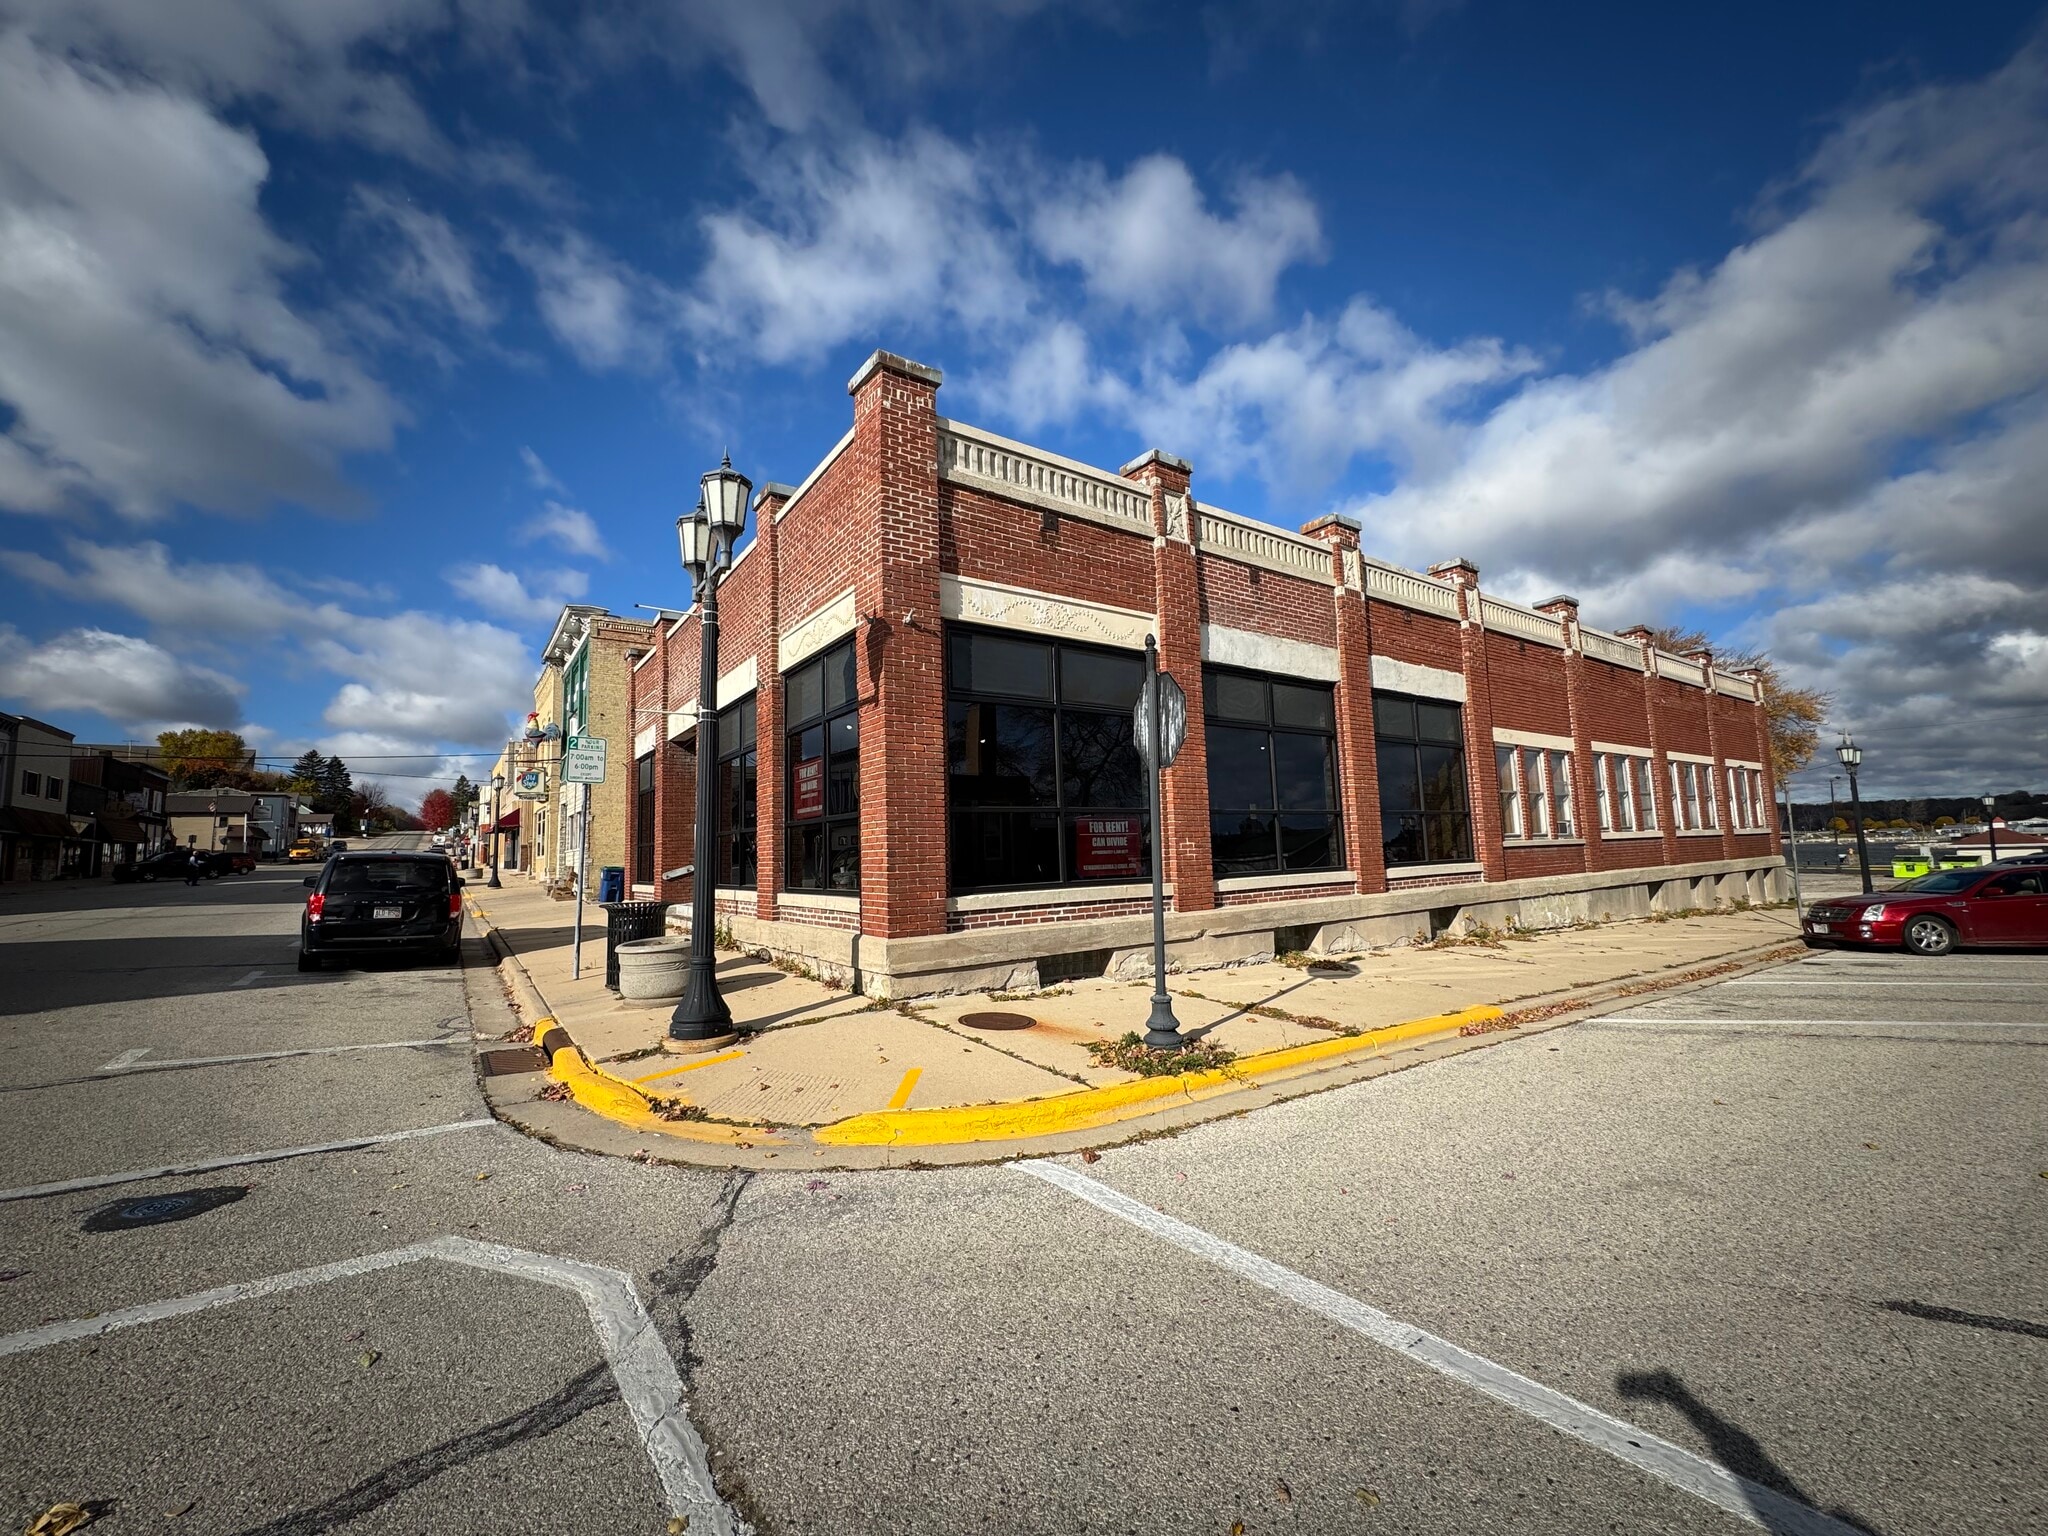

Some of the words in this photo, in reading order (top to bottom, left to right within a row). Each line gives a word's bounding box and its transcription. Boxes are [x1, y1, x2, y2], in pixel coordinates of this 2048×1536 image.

[570, 737, 577, 749] 2
[570, 753, 594, 761] 7:00am
[574, 763, 598, 771] 6:00pm
[1089, 821, 1104, 832] FOR
[1105, 821, 1129, 832] RENT!
[1092, 837, 1105, 847] CAN
[1106, 836, 1128, 847] DIVIDE
